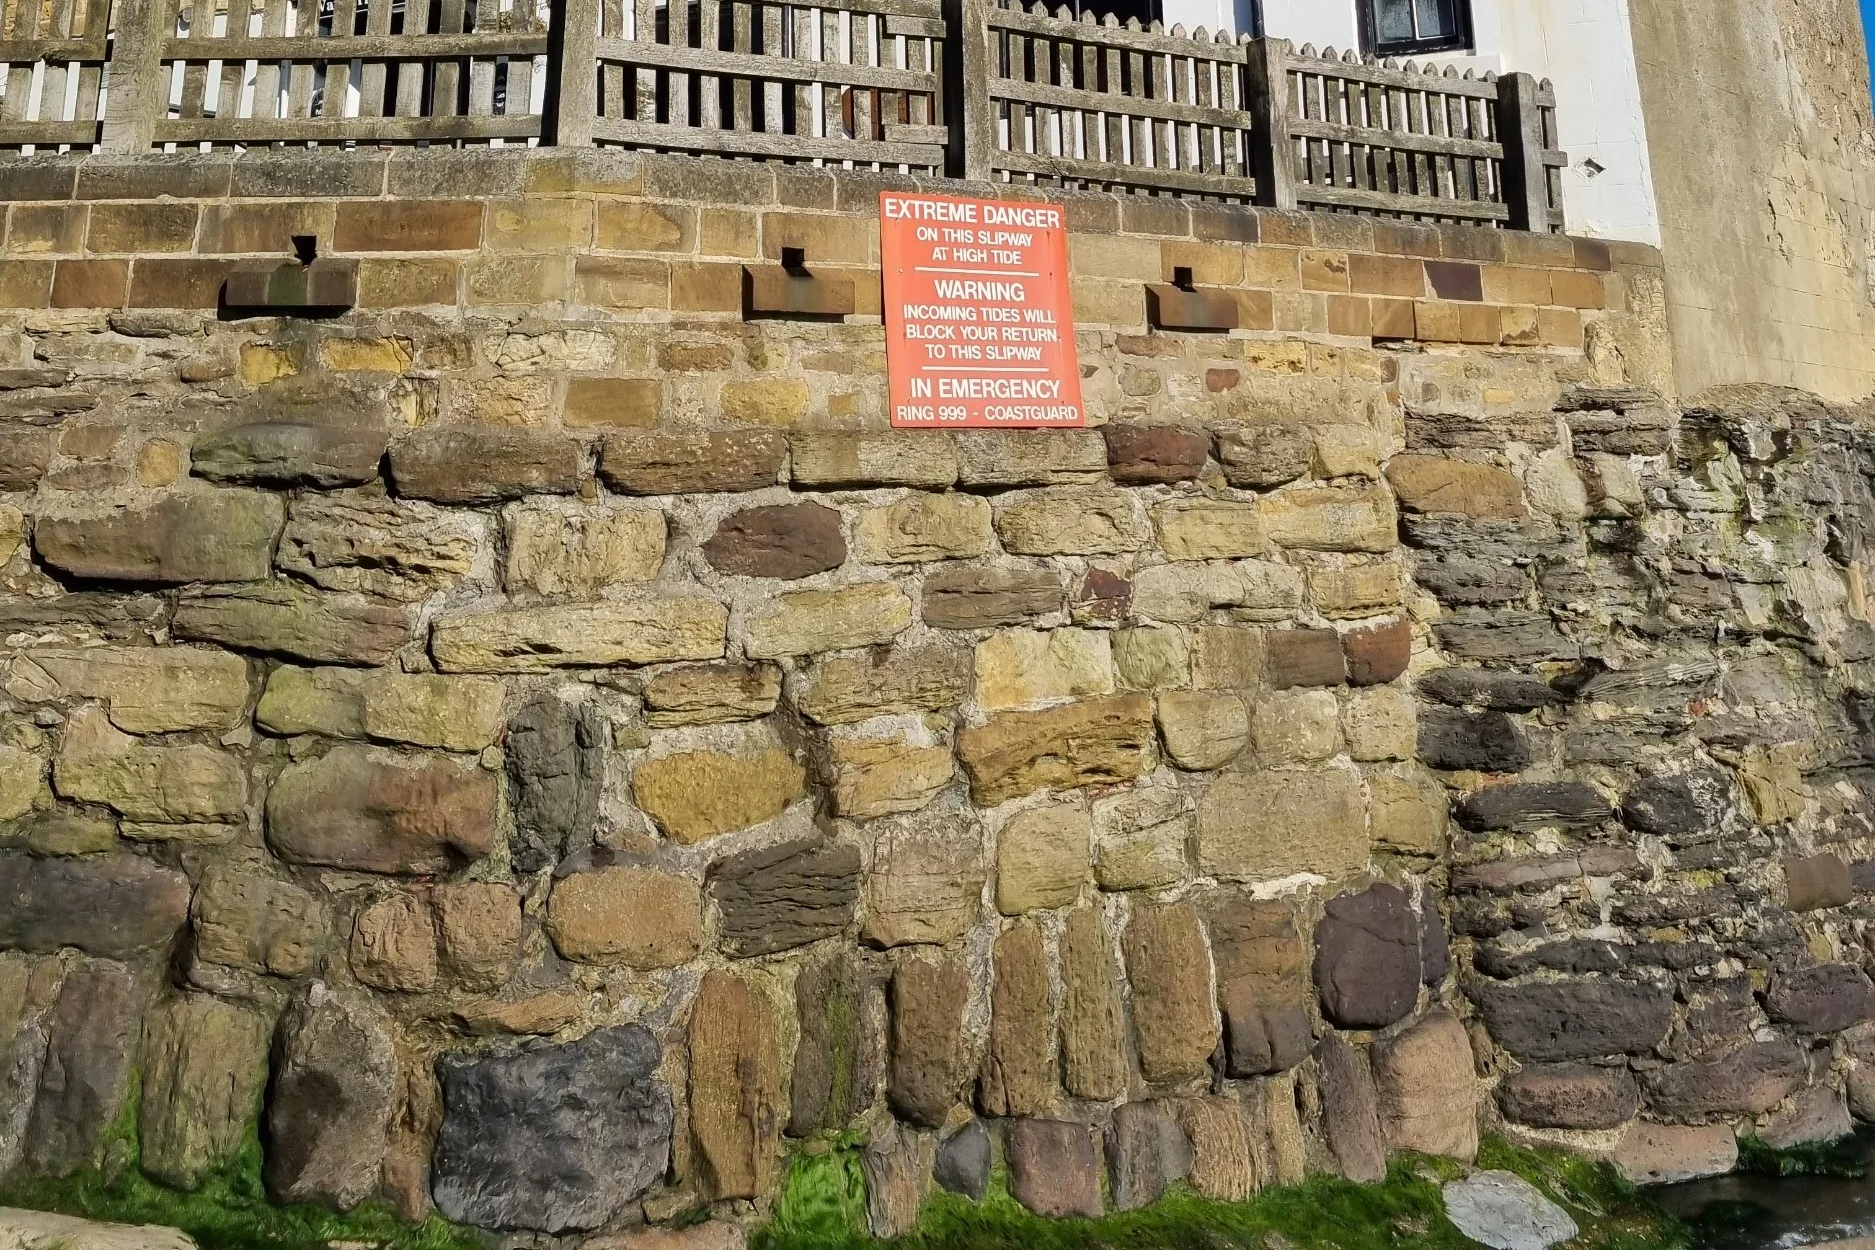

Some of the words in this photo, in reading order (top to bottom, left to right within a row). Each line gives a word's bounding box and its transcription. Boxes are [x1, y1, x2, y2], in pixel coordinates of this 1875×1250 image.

[885, 198, 977, 223] EXTREME
[984, 205, 1060, 229] DANGER
[916, 226, 938, 241] ON
[942, 228, 974, 243] THIS
[977, 230, 1033, 247] SLIPWAY
[932, 247, 948, 261] AT
[953, 248, 987, 263] HIGH
[991, 250, 1022, 265] TIDE
[934, 279, 1025, 302] WARNING
[904, 304, 977, 321] INCOMING
[980, 307, 1020, 323] TIDES
[1023, 309, 1056, 324] WILL
[906, 324, 955, 339] BLOCK
[960, 325, 998, 341] YOUR
[1002, 327, 1057, 342] RETURN
[925, 344, 946, 359] TO
[949, 344, 982, 360] THIS
[985, 346, 1042, 361] SLIPWAY
[911, 378, 931, 399] IN
[939, 378, 1060, 399] EMERGENCY
[897, 406, 934, 421] RING
[938, 405, 967, 420] 999
[984, 405, 1078, 421] COASTGUARD
